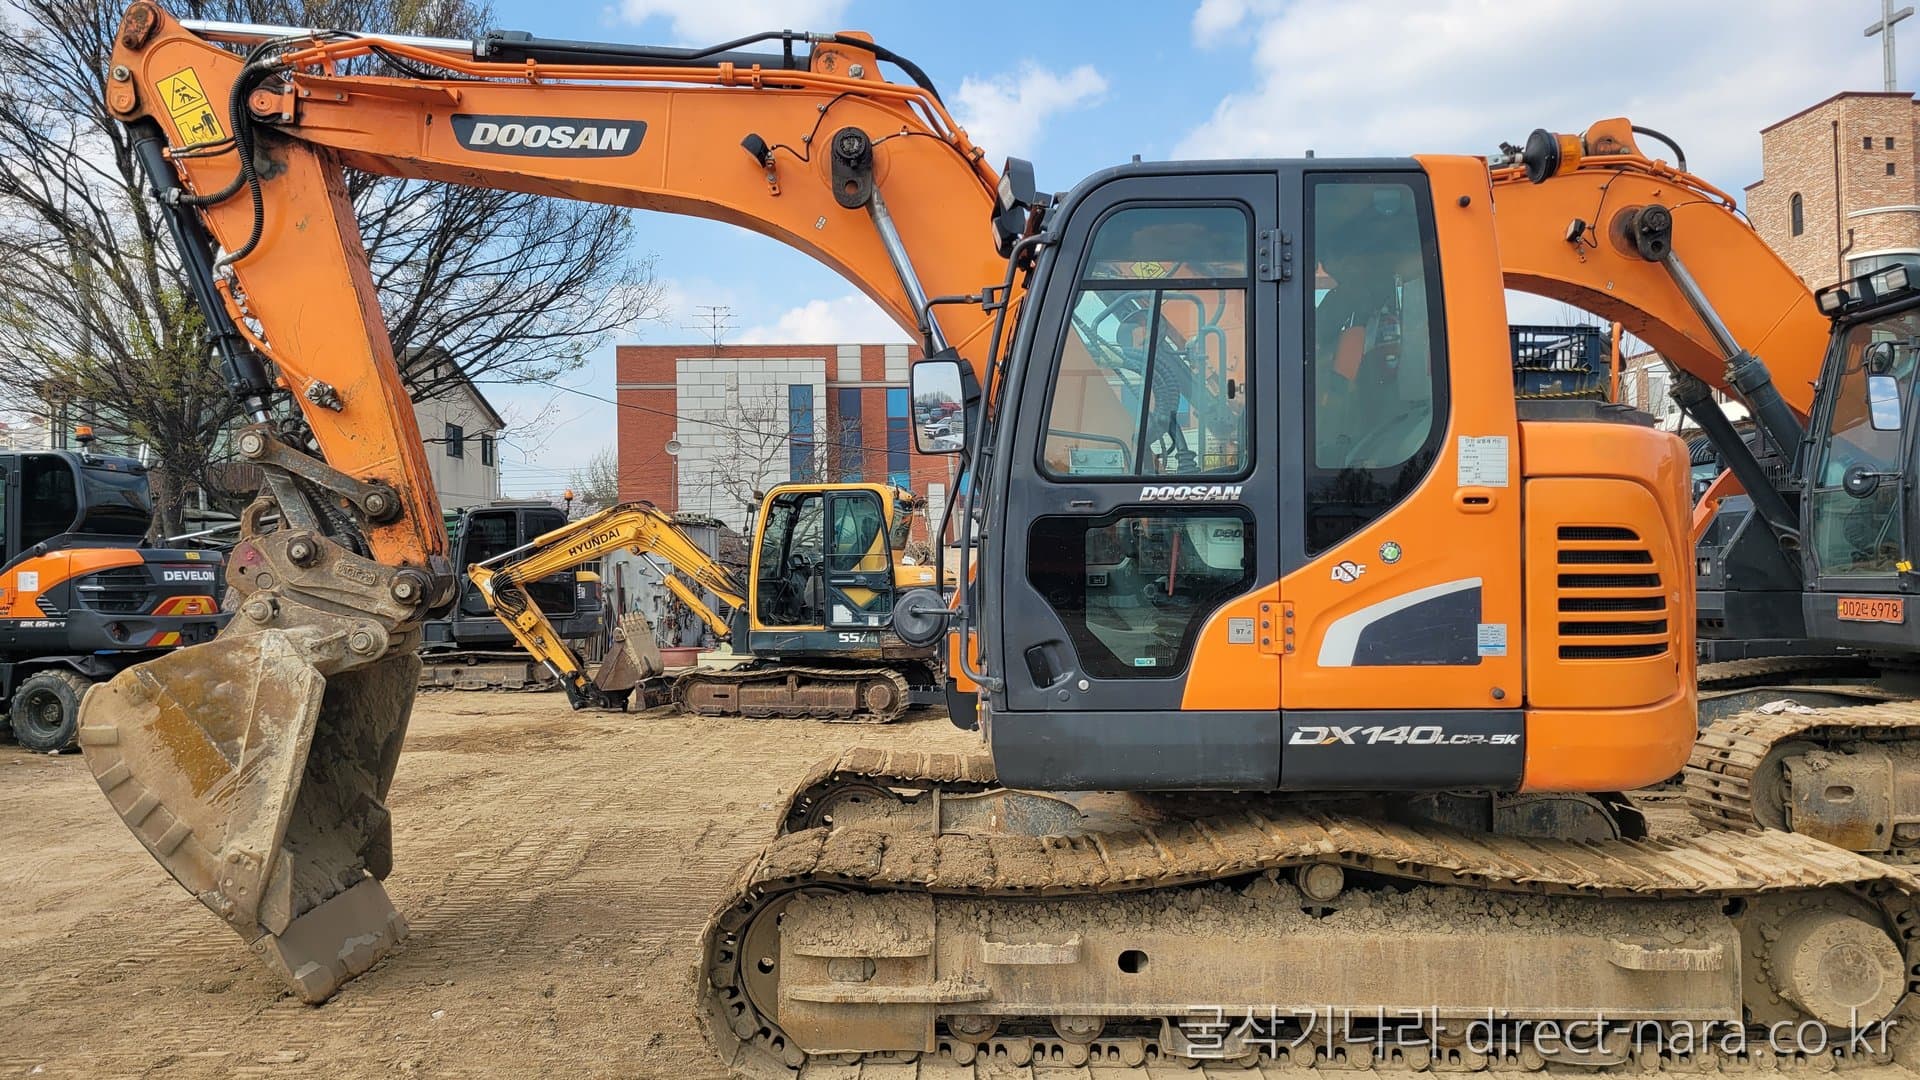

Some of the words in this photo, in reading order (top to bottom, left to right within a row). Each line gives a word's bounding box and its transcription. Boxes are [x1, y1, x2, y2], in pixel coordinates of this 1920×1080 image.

[469, 122, 630, 151] DOOSAN
[1139, 486, 1243, 501] DOOSAN
[568, 528, 621, 556] HYUNDAI
[163, 570, 215, 582] DEVELON
[1870, 602, 1899, 618] 6978
